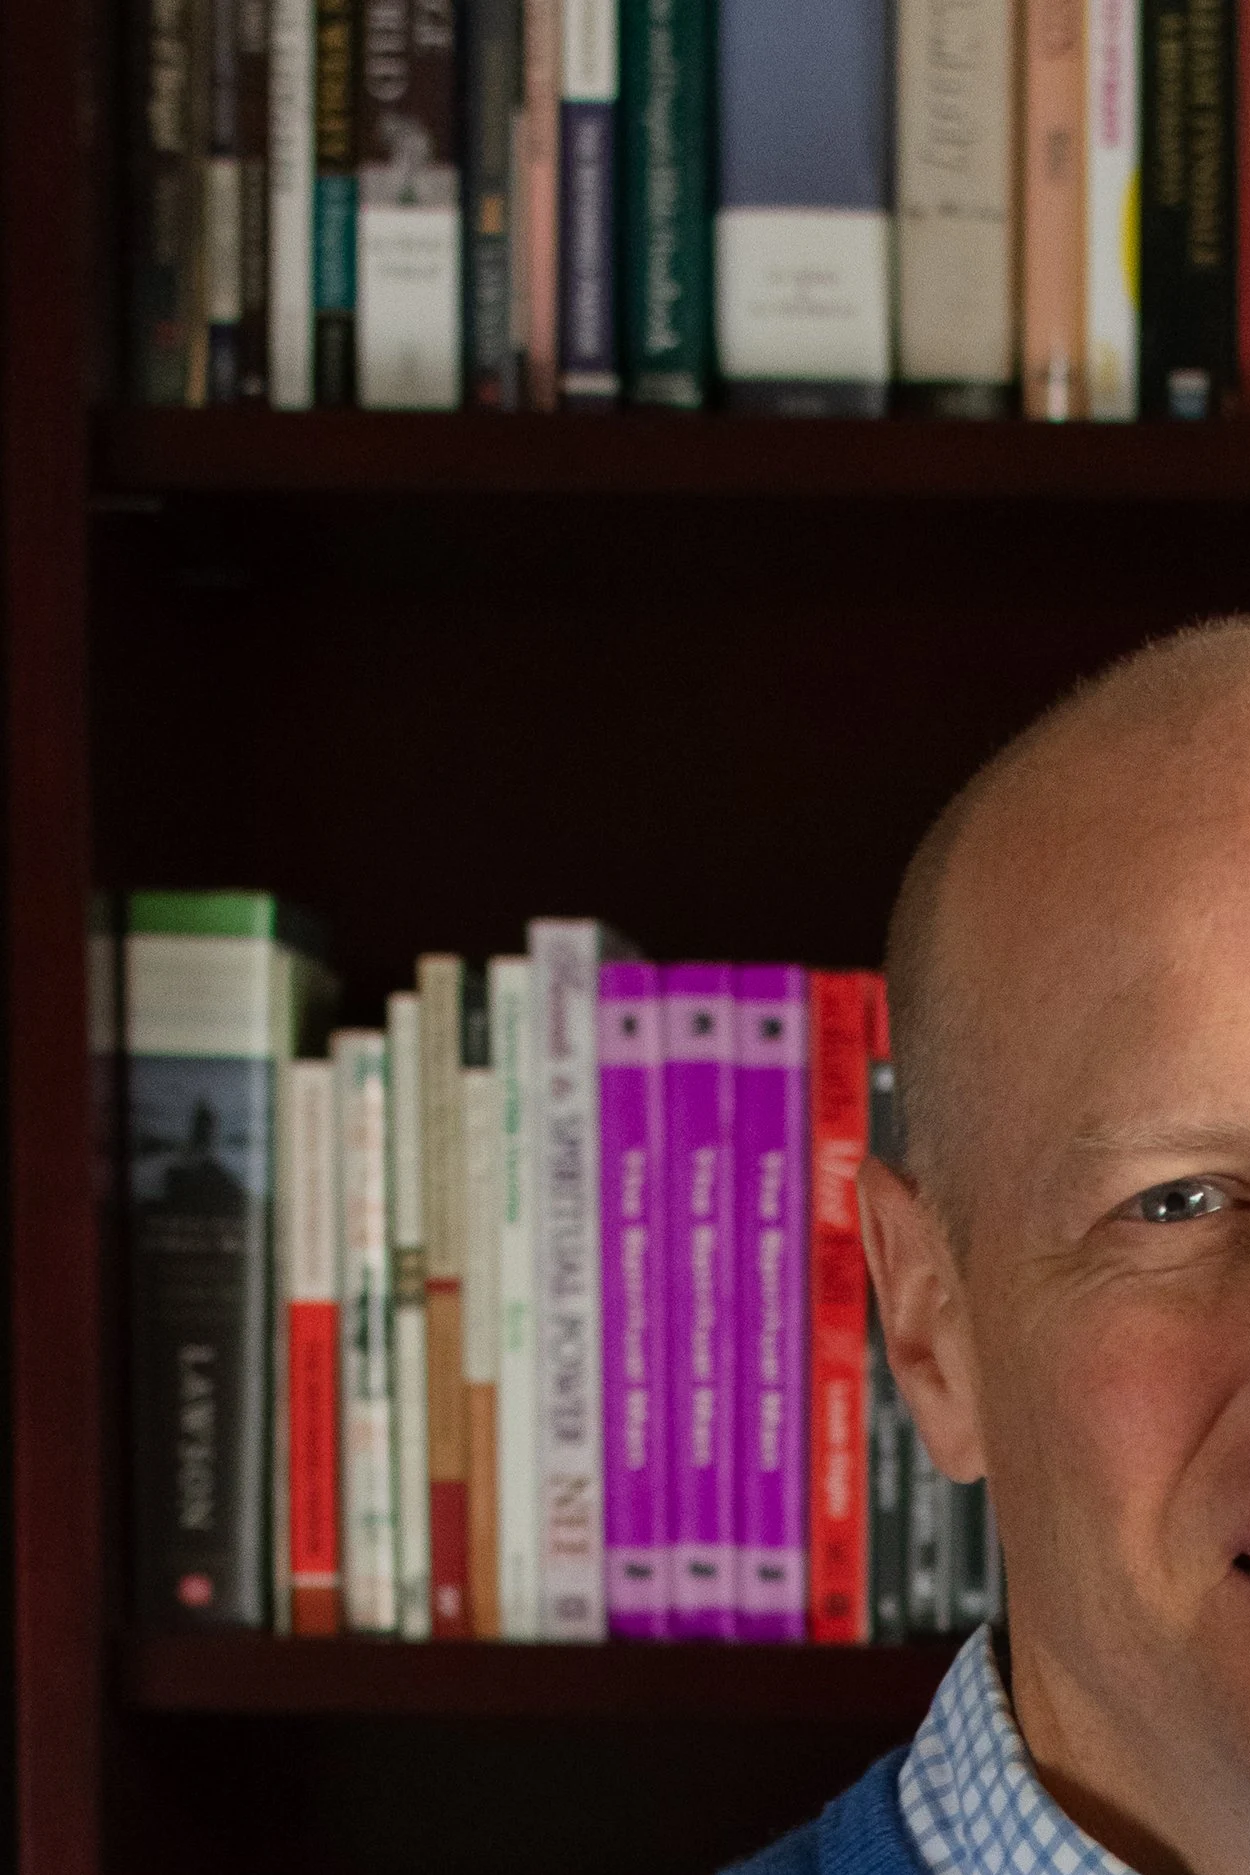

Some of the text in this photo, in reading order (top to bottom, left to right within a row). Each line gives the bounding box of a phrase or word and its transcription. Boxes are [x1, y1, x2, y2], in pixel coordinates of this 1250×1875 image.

[550, 1112, 587, 1299] SPIRITUAL
[177, 1341, 218, 1532] LAWSON
[550, 1314, 587, 1444] POWER
